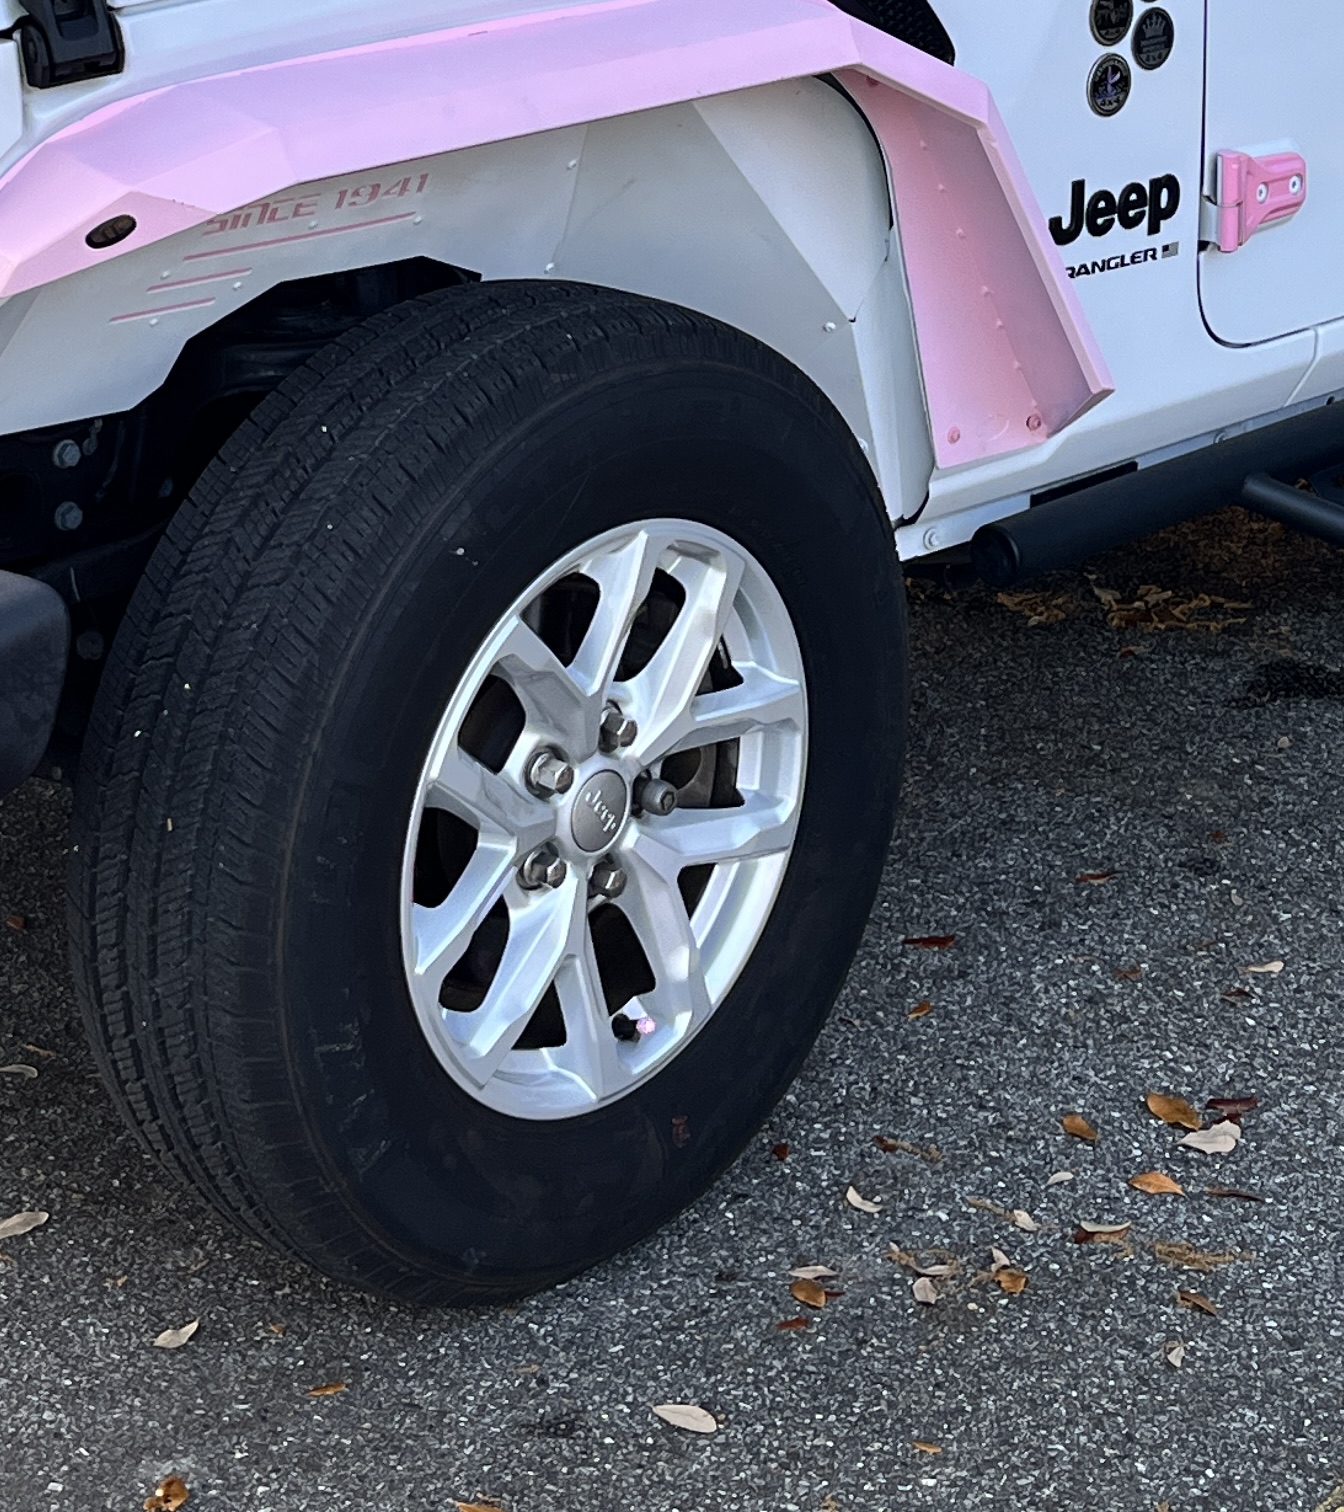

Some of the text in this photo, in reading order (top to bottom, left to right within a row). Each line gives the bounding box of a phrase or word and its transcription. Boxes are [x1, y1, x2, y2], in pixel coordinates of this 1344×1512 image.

[203, 172, 429, 236] SINCE 1941
[1048, 173, 1181, 246] Jeep
[1066, 247, 1158, 279] RANGLER
[585, 790, 617, 833] Jeep
